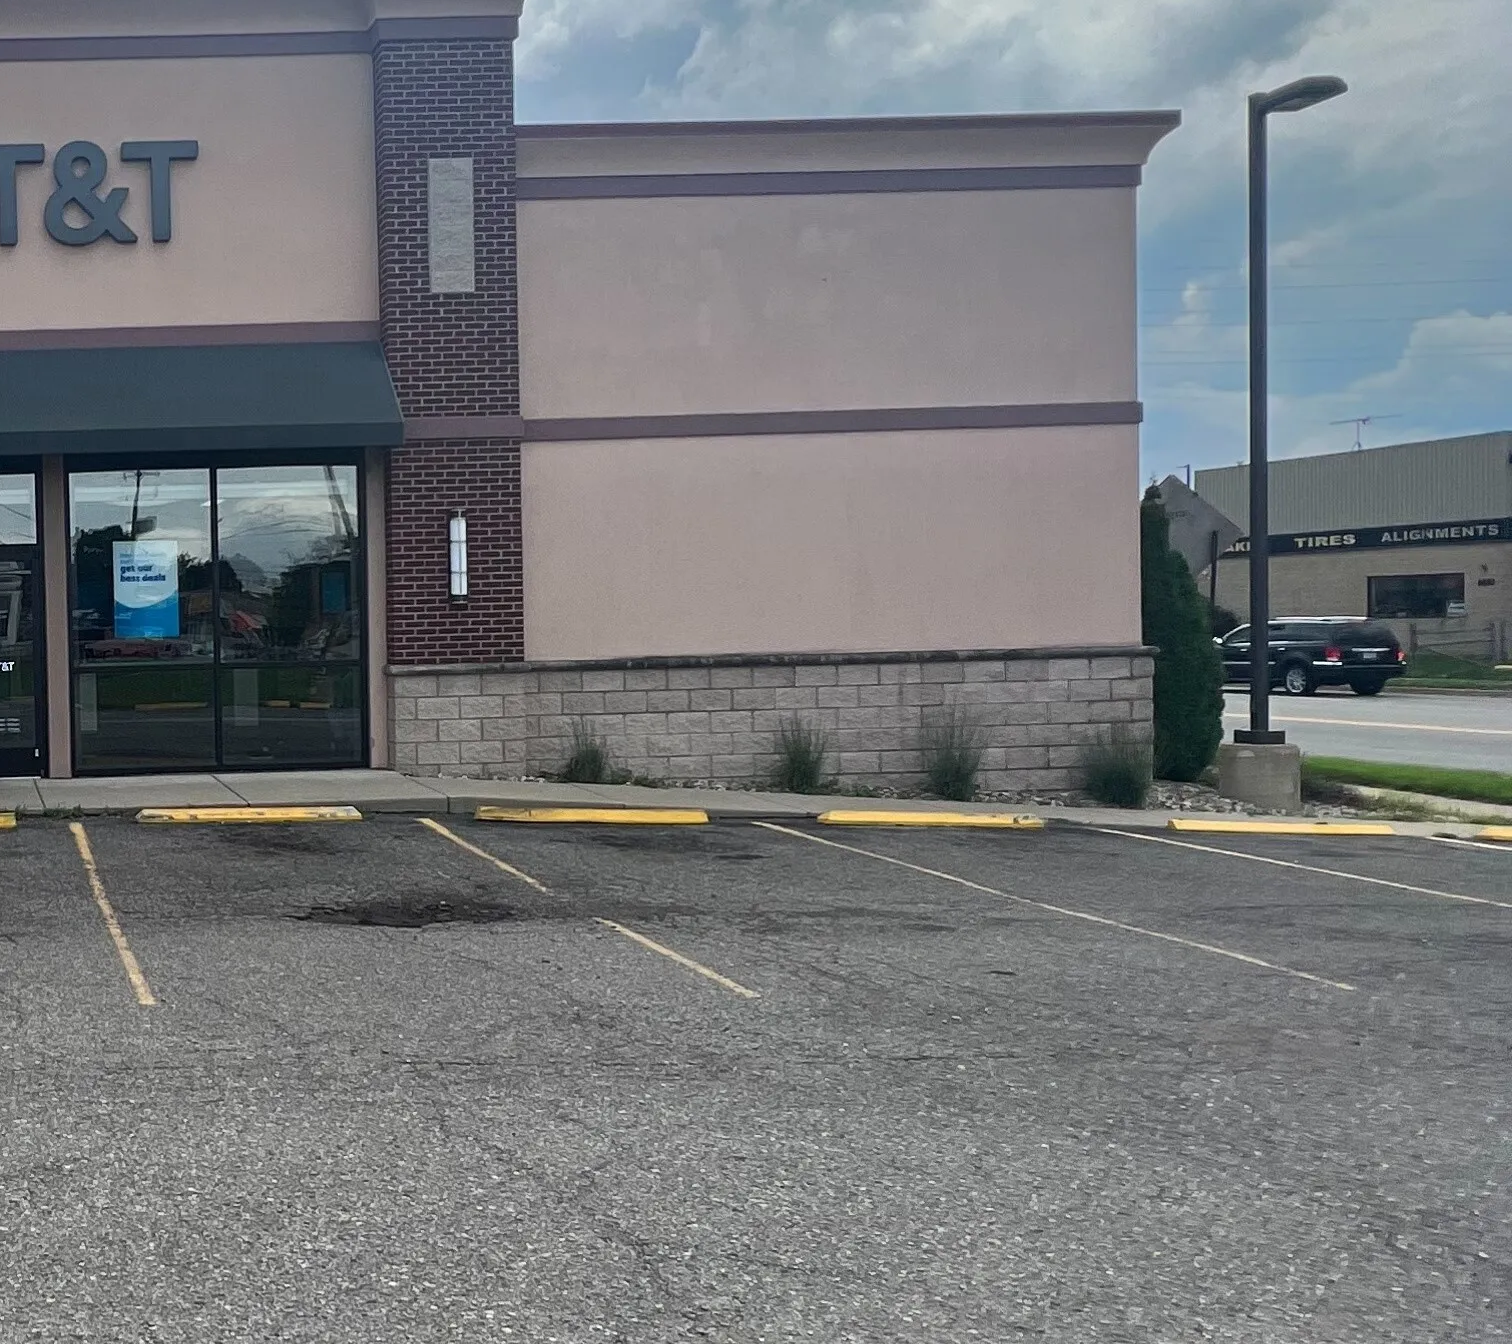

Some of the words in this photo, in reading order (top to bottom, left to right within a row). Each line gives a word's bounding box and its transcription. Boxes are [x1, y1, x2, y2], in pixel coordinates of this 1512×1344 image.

[1293, 534, 1357, 549] TIRES
[1381, 524, 1500, 543] ALIGNMENTS
[120, 565, 136, 575] get
[137, 564, 154, 572] our
[120, 574, 140, 583] best
[142, 573, 166, 582] deals
